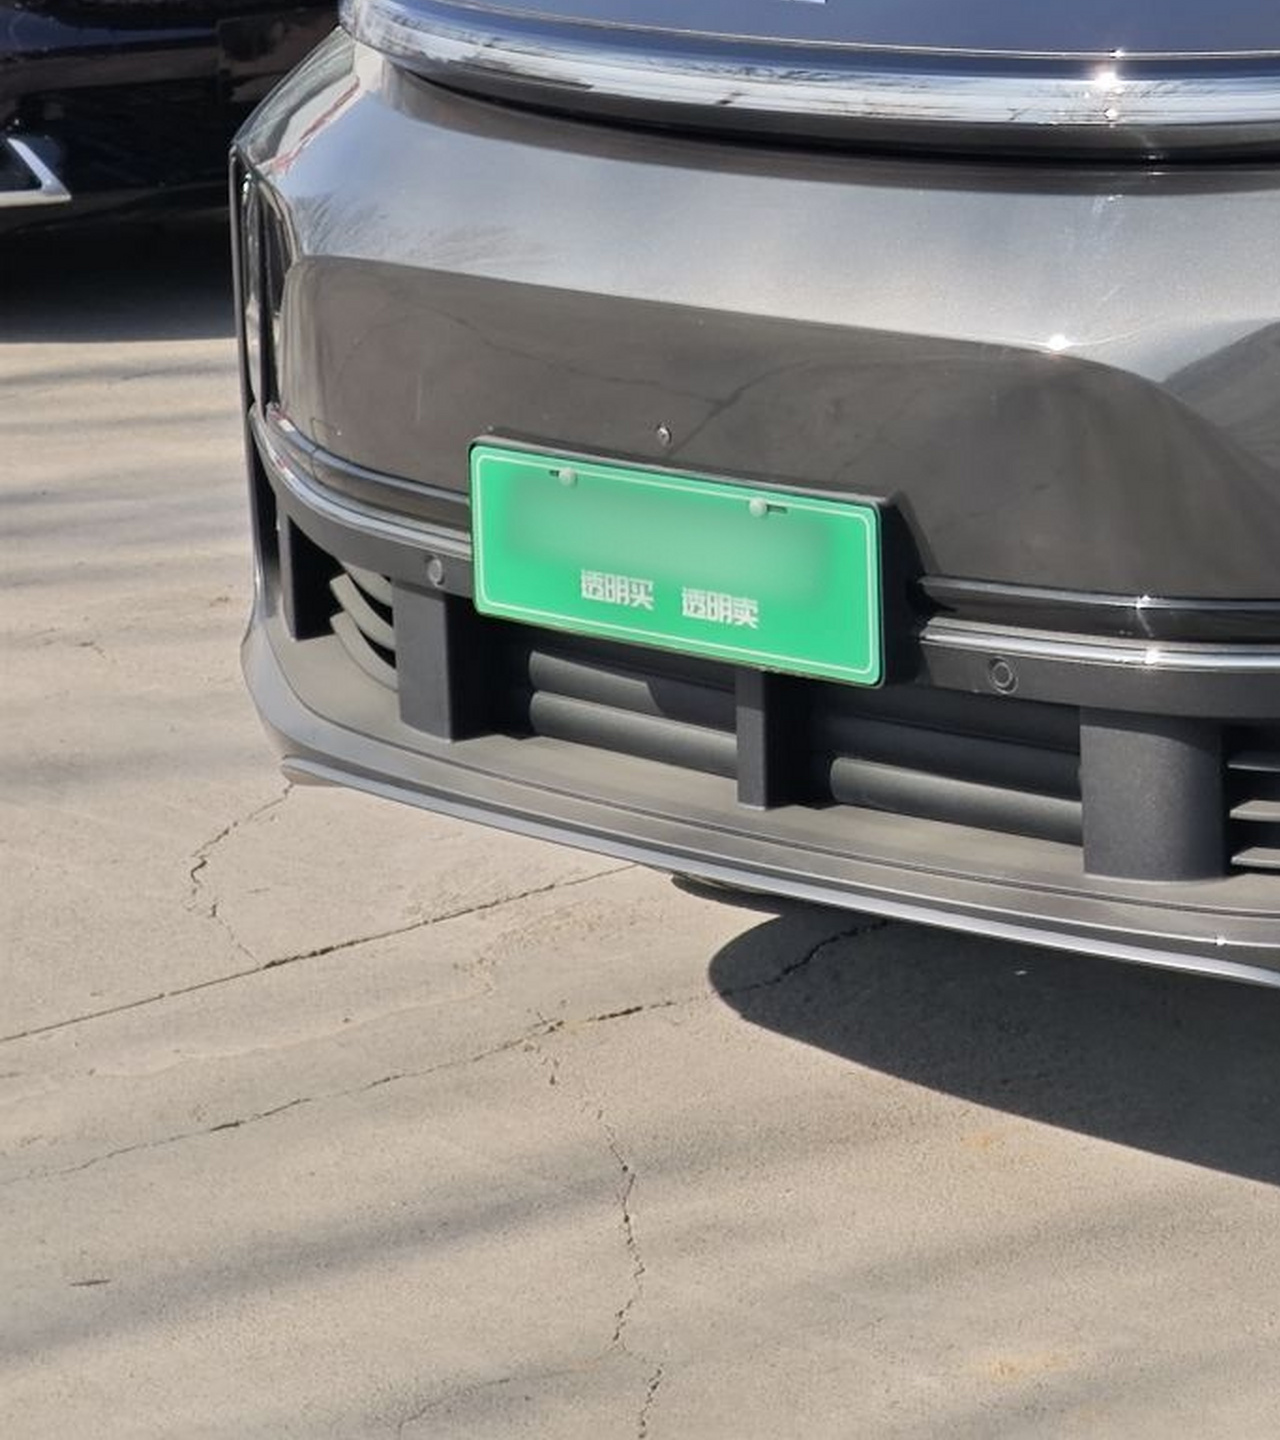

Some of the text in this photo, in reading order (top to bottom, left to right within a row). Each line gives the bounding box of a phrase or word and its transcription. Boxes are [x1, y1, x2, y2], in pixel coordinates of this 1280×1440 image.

[581, 569, 759, 629] 透明买 透明卖
